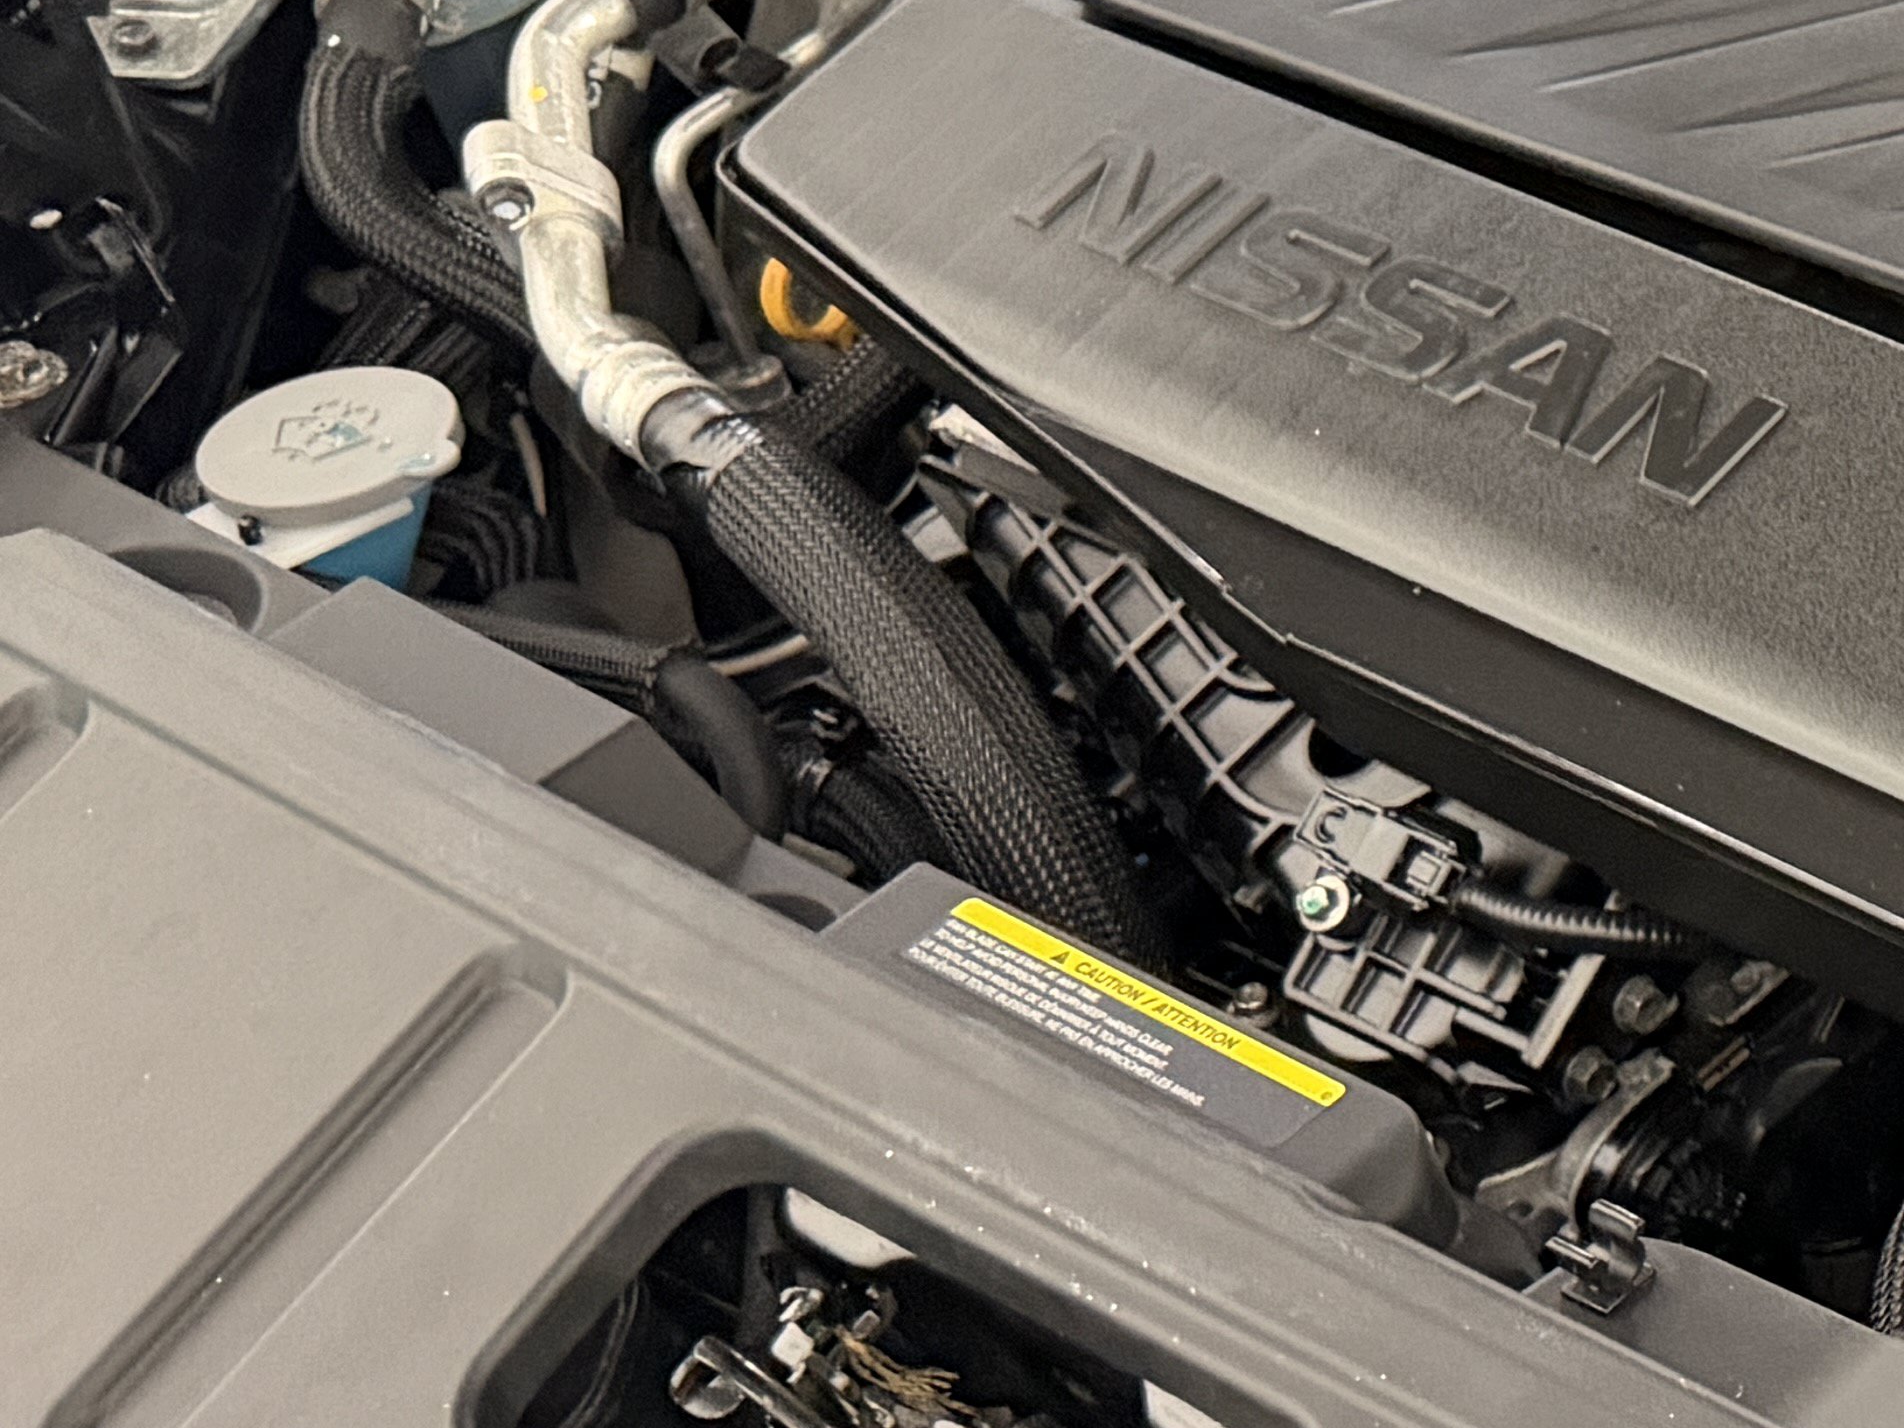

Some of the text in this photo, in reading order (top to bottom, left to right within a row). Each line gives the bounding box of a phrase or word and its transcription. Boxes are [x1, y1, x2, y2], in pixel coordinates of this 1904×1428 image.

[1013, 128, 1788, 508] NISSAN
[1073, 958, 1146, 1003] CAUTION
[1150, 997, 1241, 1053] ATTENTION
